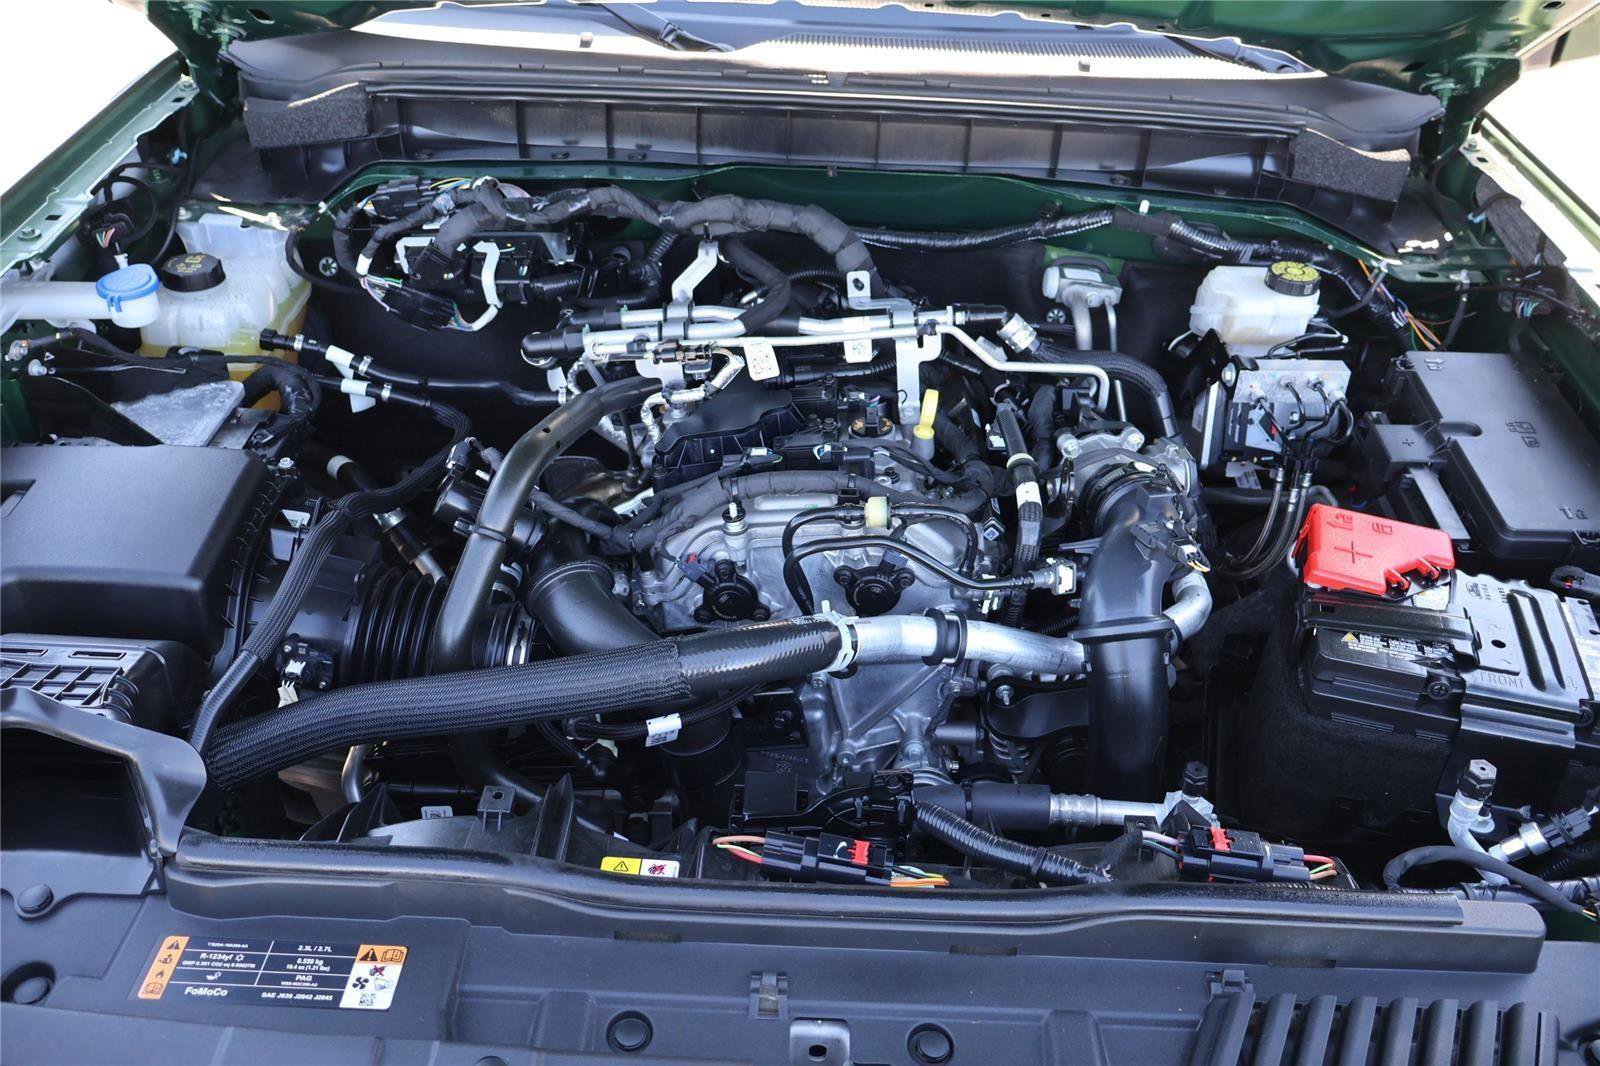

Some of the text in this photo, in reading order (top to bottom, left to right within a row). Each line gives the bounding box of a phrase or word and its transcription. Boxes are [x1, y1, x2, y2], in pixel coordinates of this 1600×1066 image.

[199, 952, 235, 962] R-1234yf
[296, 957, 324, 966] 0.550 kg
[295, 974, 313, 982] PAG
[184, 986, 228, 996] FoMoCo
[261, 991, 277, 999] SAE
